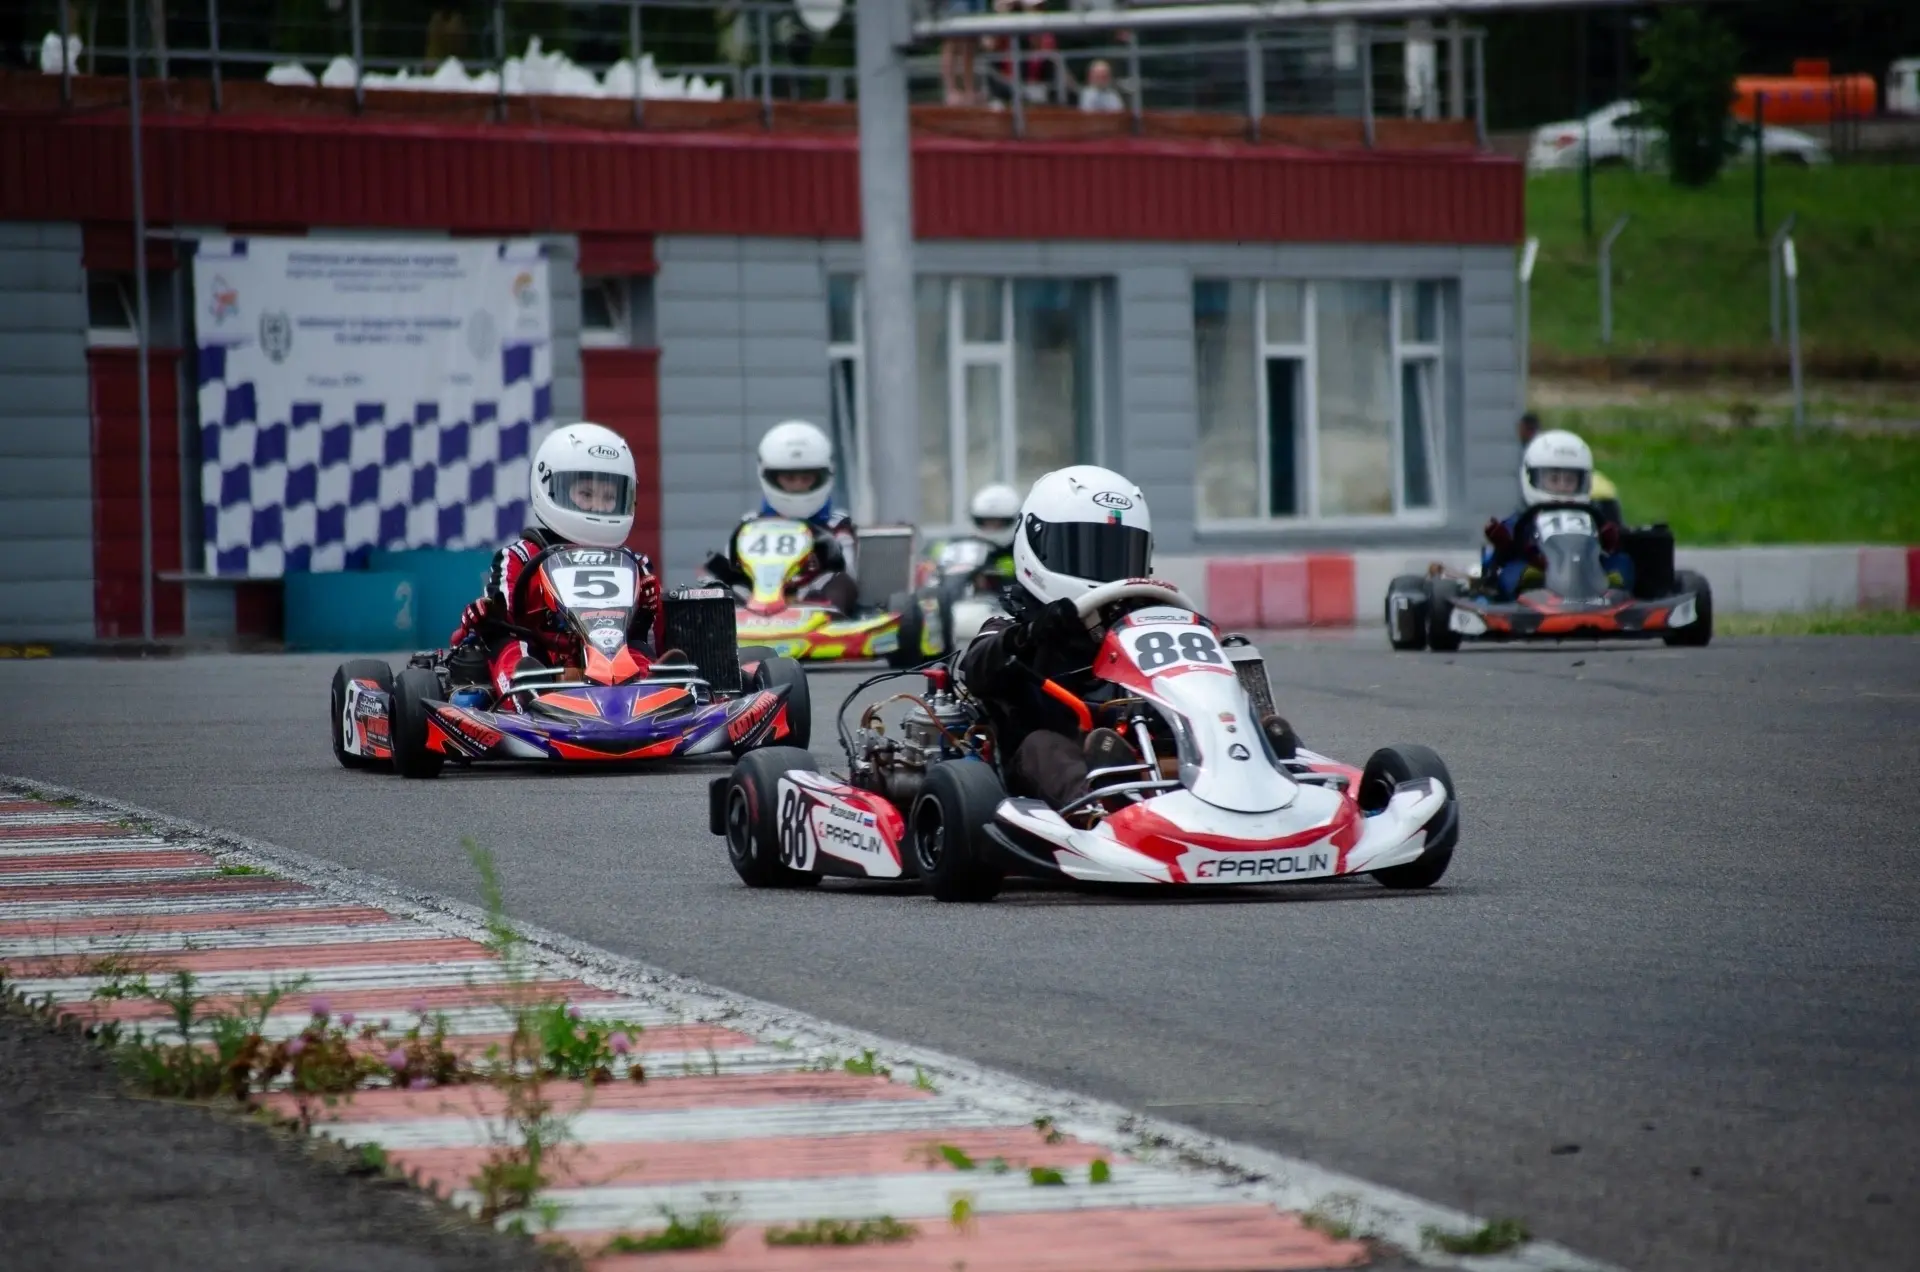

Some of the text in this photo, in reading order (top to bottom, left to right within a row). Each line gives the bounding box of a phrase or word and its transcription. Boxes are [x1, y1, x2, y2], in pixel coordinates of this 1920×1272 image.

[592, 445, 616, 457] Arai
[1097, 493, 1130, 506] Arai
[747, 534, 796, 556] 48
[572, 571, 621, 599] 5
[395, 581, 413, 630] 2
[1134, 631, 1223, 671] 88
[345, 689, 354, 748] 5
[462, 734, 488, 751] TEAM
[782, 788, 807, 869] 88
[825, 823, 882, 855] PAROLIN
[1216, 853, 1328, 878] PAROLIN
